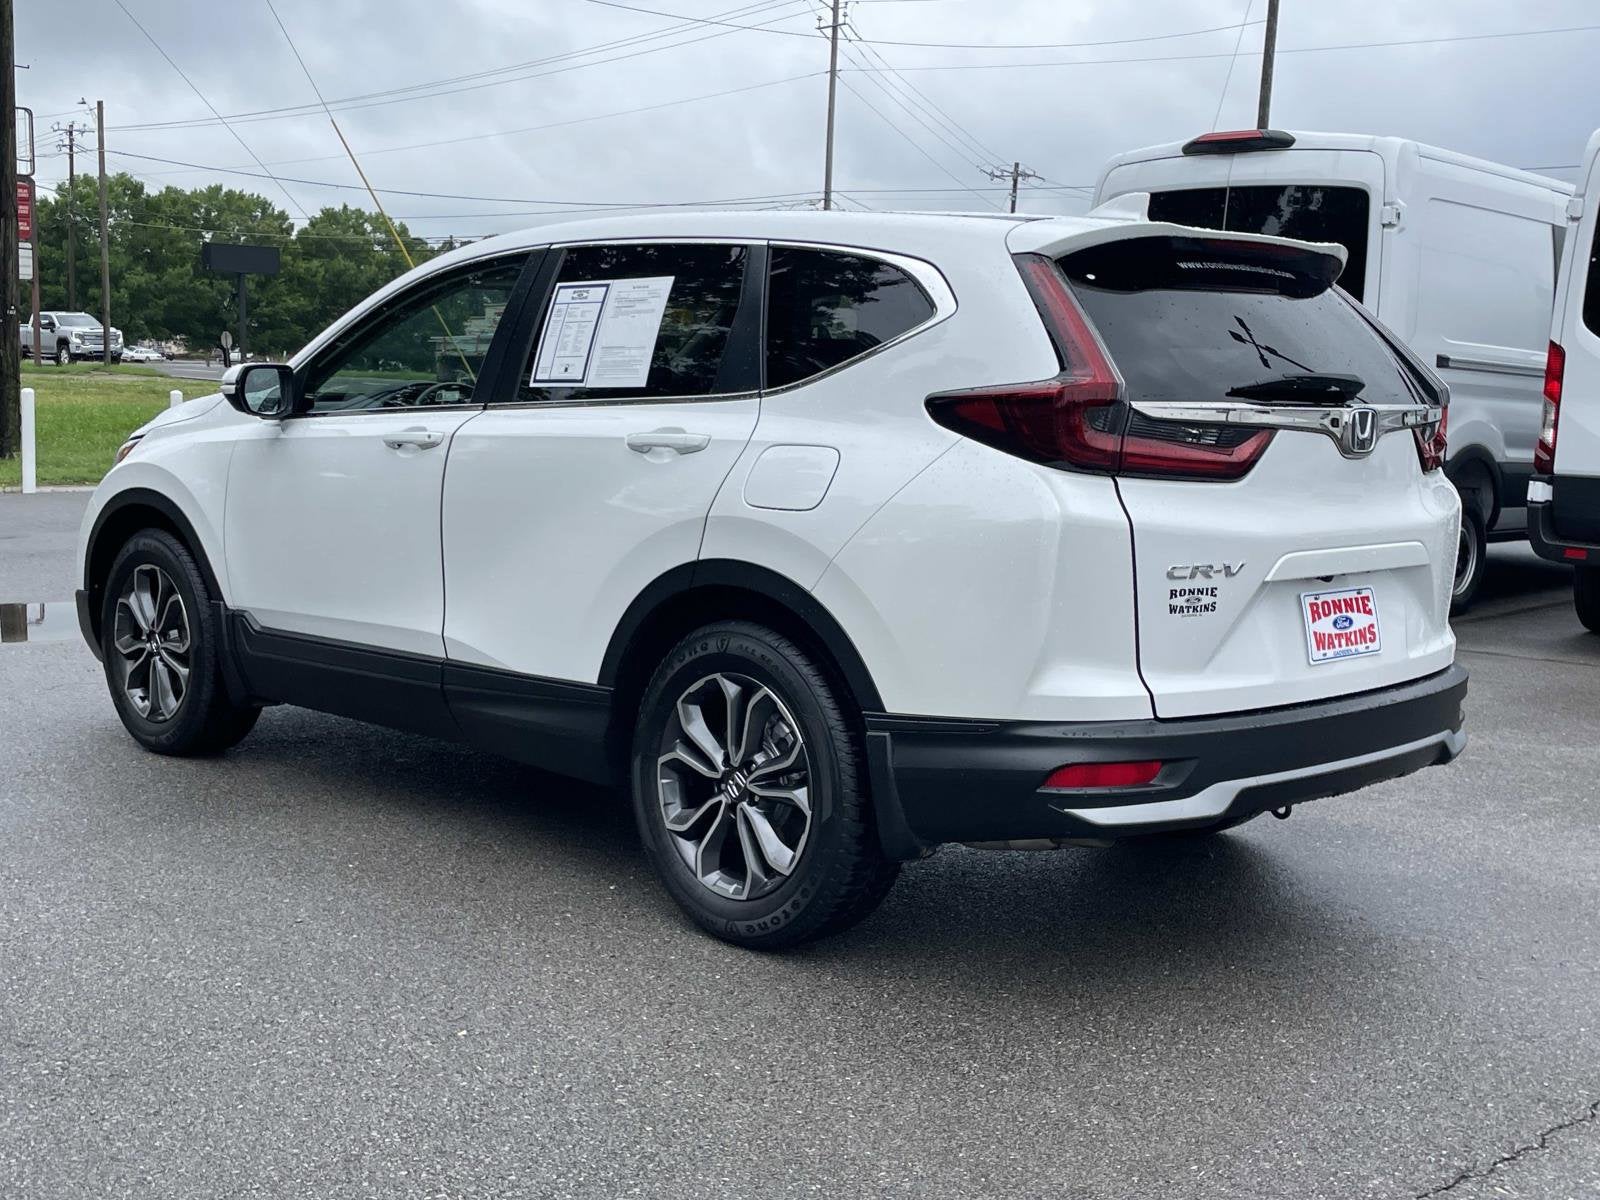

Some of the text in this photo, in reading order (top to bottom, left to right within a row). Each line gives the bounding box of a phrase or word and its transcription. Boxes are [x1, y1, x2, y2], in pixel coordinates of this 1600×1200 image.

[1166, 560, 1247, 580] CR-V
[1169, 586, 1218, 600] RONNIE
[1168, 601, 1217, 615] WATKINS
[1309, 595, 1373, 624] RONNIE
[1336, 616, 1350, 629] Ford
[1313, 623, 1377, 651] WATKINS
